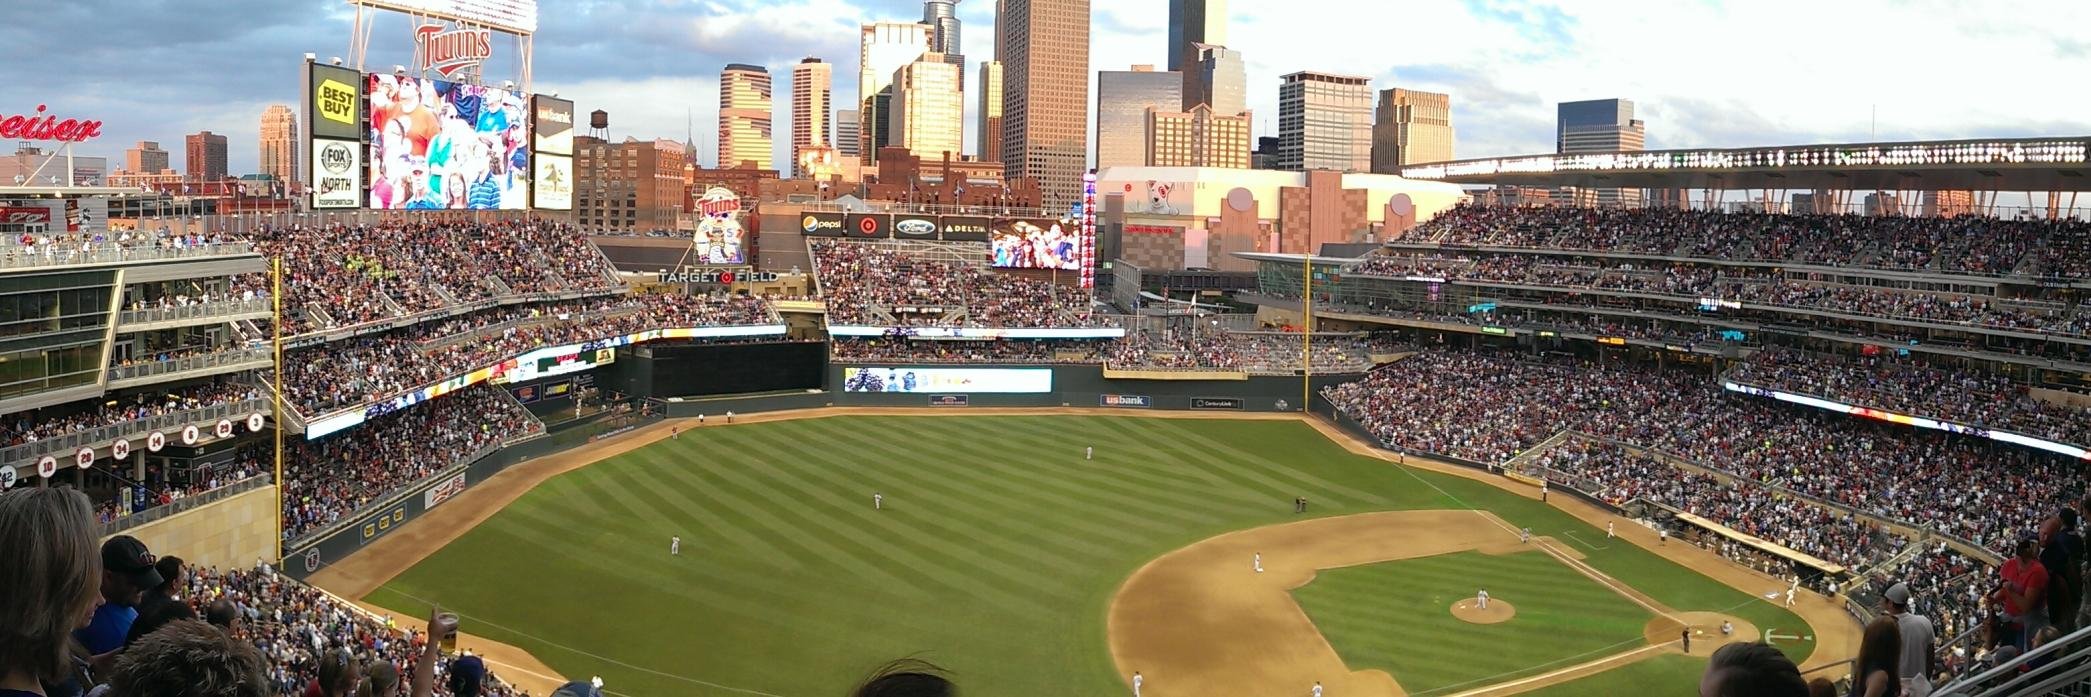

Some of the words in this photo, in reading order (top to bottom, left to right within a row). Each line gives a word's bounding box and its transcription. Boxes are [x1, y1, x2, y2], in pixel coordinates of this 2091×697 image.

[415, 20, 491, 71] Twins
[323, 86, 354, 105] BEST
[324, 100, 350, 117] BUY
[0, 104, 102, 142] eiser
[328, 149, 346, 162] FOX
[322, 177, 352, 191] NORTH
[697, 198, 741, 220] Twins
[818, 220, 841, 230] pepsi
[904, 222, 928, 232] Ford
[659, 272, 720, 282] TARGET
[735, 272, 779, 282] FIELD
[1106, 395, 1144, 405] usbank
[253, 418, 259, 427] 3
[152, 436, 161, 447] 14
[116, 444, 127, 455] 34
[43, 461, 53, 473] 10
